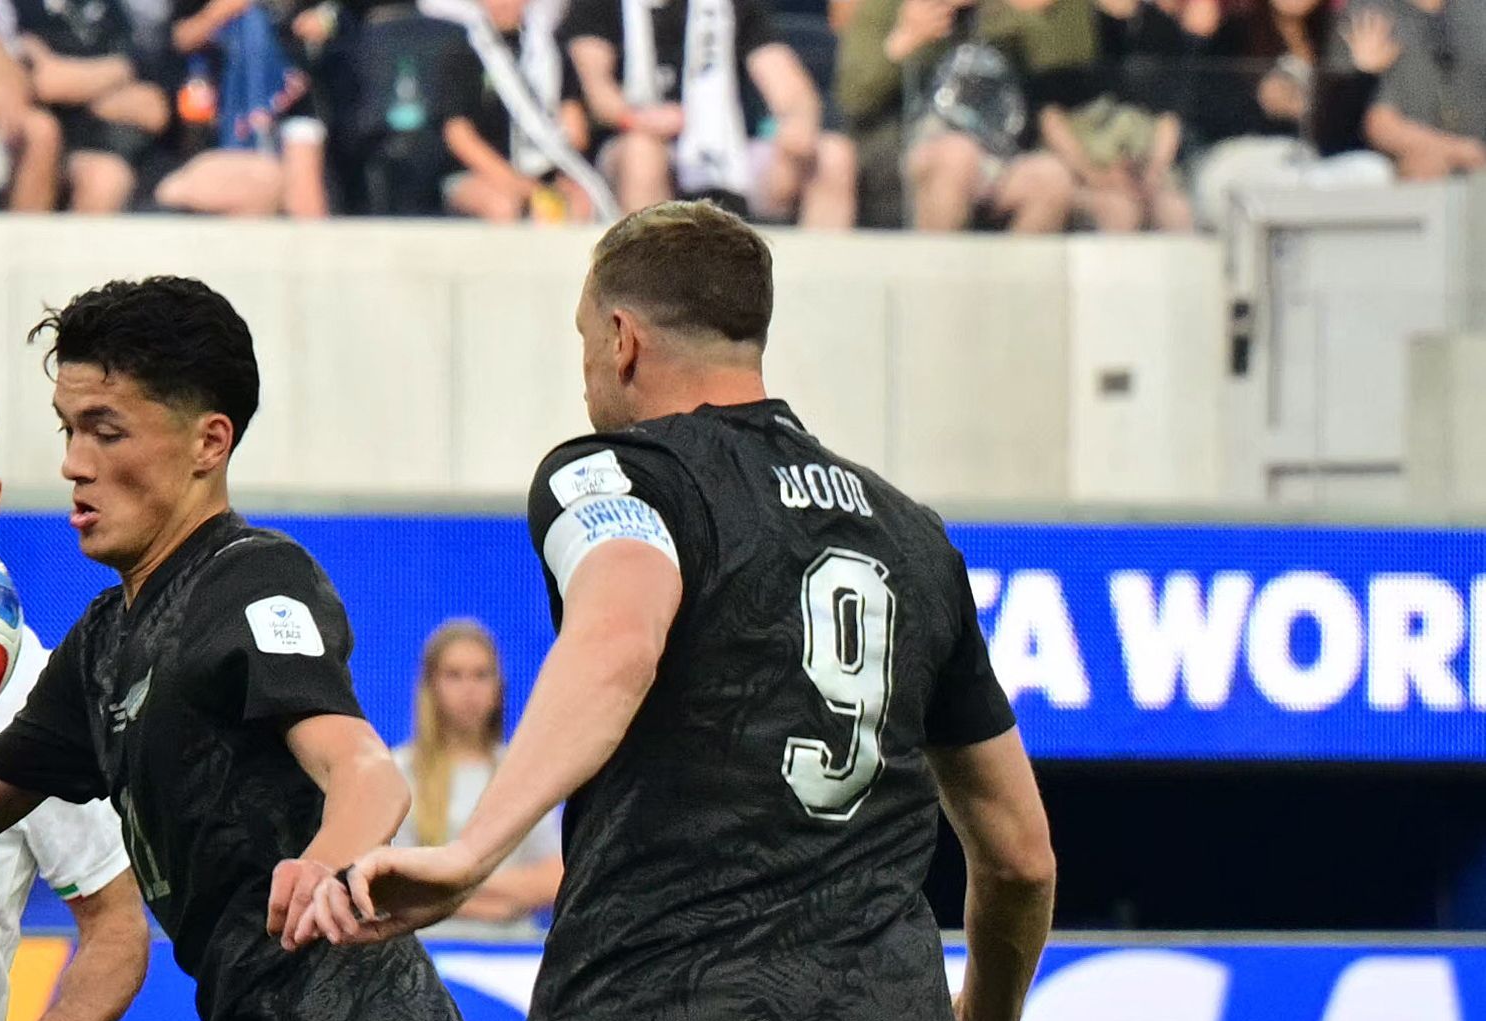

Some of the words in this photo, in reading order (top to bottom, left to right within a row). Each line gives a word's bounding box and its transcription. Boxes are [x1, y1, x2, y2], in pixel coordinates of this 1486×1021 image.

[771, 463, 873, 517] WOOD
[781, 547, 896, 822] 9
[1109, 569, 1486, 712] WOR
